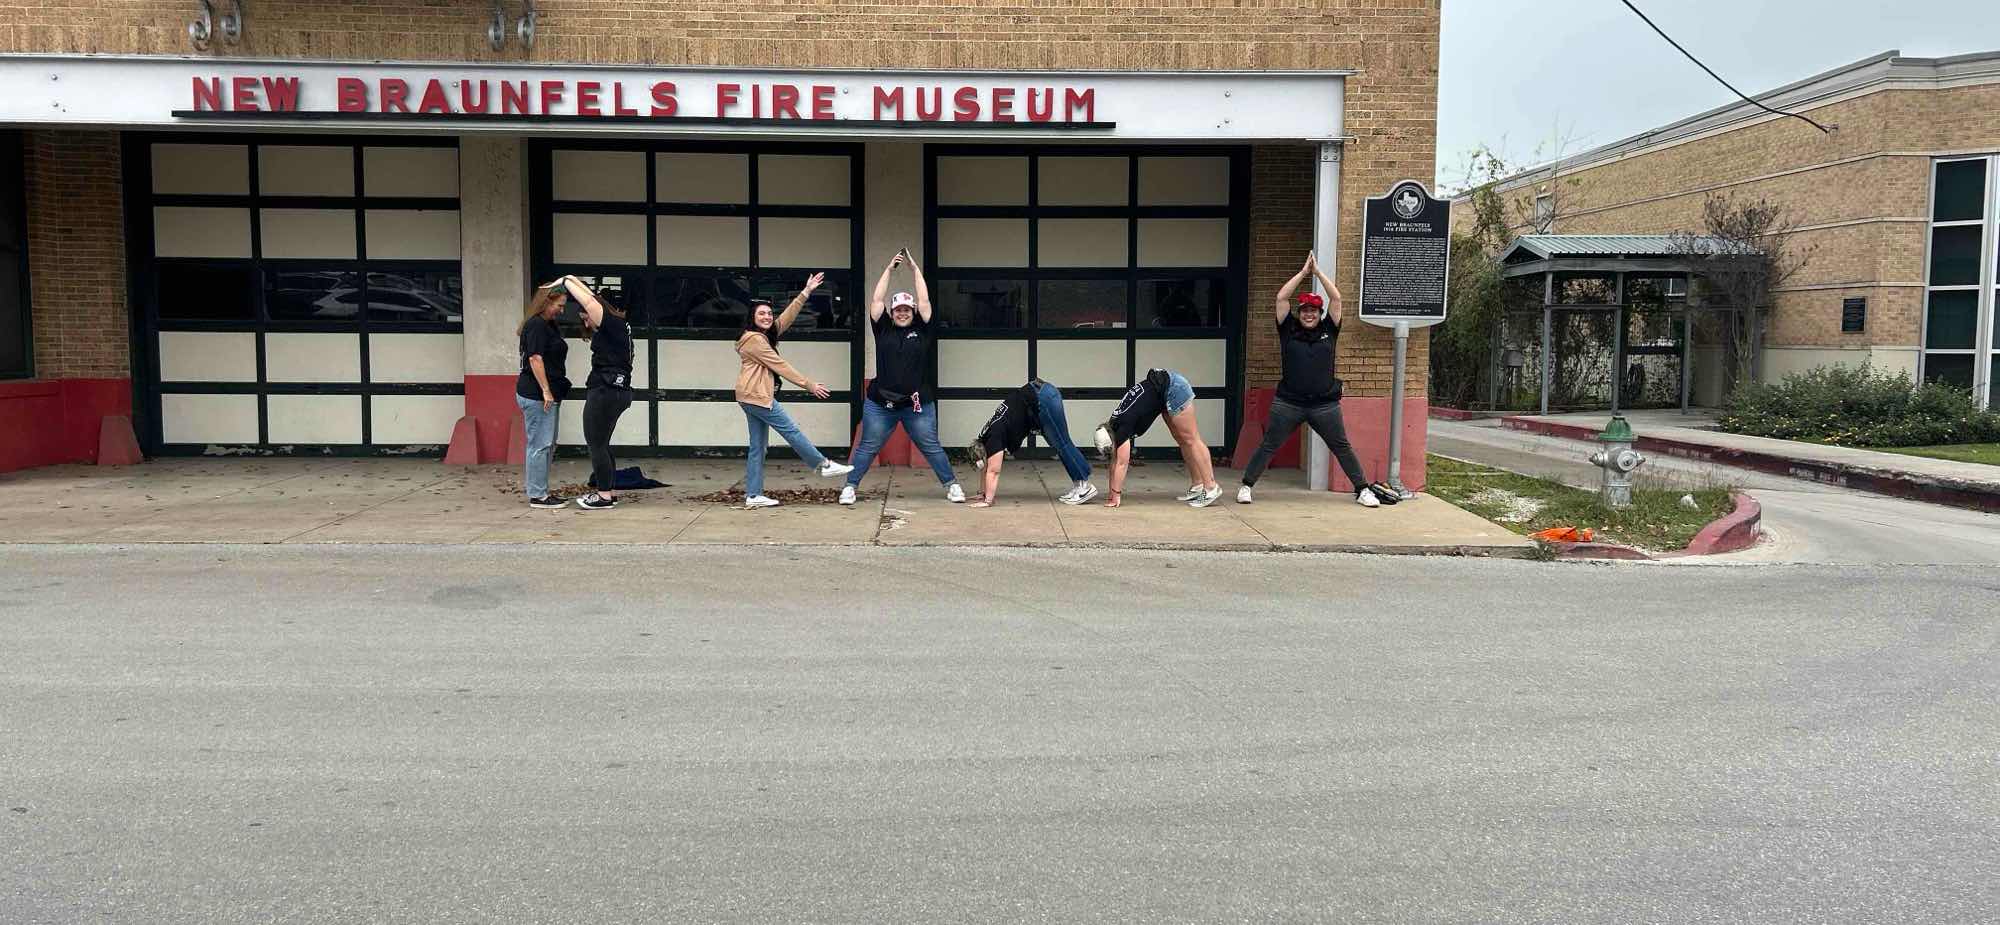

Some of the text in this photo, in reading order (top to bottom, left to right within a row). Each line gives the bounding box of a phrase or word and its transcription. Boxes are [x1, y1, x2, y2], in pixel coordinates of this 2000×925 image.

[192, 77, 1095, 123] NEW BRAUNFELS FIRE MUSEUM
